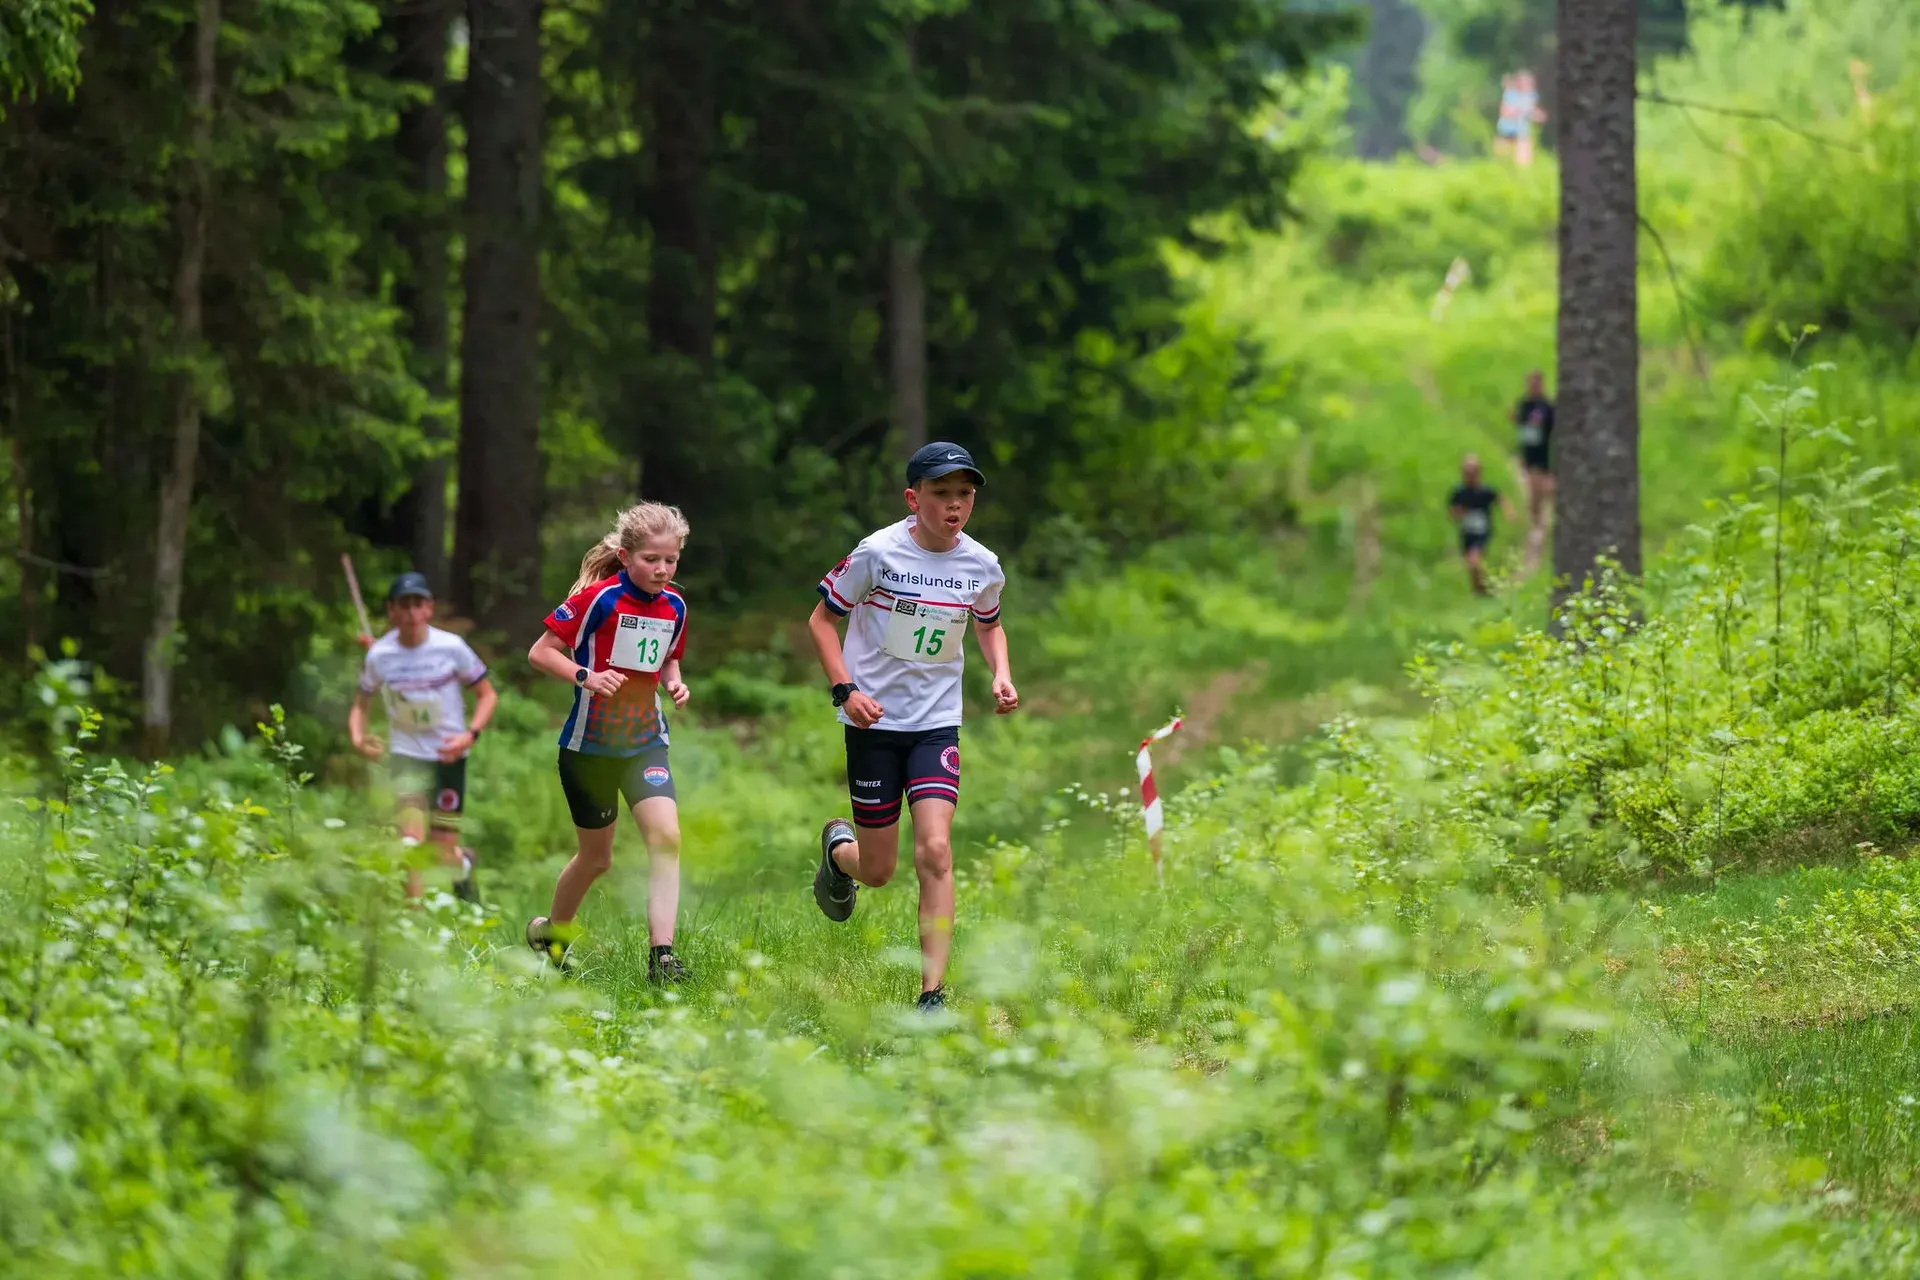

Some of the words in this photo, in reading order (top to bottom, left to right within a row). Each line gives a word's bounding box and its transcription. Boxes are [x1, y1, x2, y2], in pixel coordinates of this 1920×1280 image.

[881, 568, 962, 590] Karlslunds
[967, 577, 980, 591] IF
[637, 637, 659, 665] 13
[913, 626, 946, 656] 15
[411, 707, 430, 725] 14
[855, 779, 882, 788] TRIMTEX
